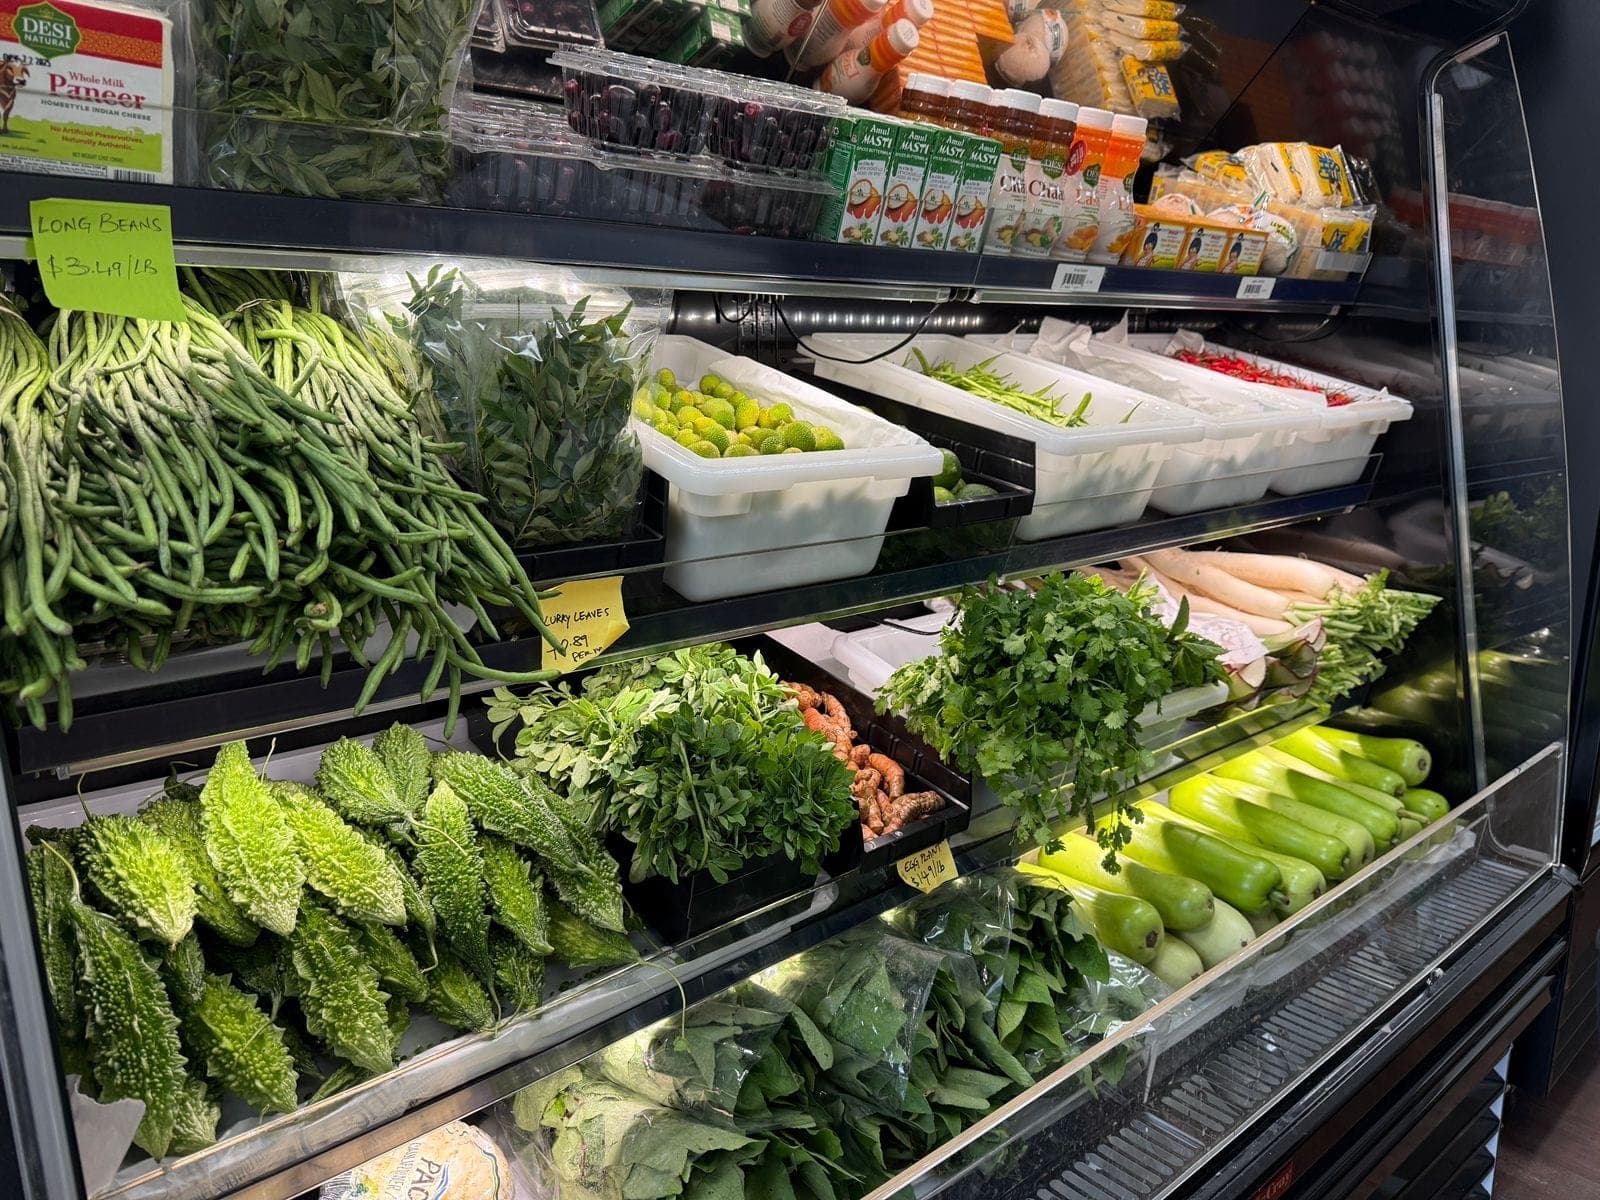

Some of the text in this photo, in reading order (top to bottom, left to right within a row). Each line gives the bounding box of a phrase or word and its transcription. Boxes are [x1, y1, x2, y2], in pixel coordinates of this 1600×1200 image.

[22, 16, 72, 40] DESI
[24, 33, 71, 49] NATURAL
[69, 71, 125, 88] Whole Milk
[48, 73, 147, 110] Paneer
[41, 98, 152, 121] HOMESTYLE INDIAN CHEESE
[51, 125, 62, 133] No
[62, 126, 94, 137] Artificial
[870, 124, 890, 136] Amul
[908, 131, 928, 142] Amul
[62, 135, 96, 147] Naturally
[861, 134, 892, 149] MASTI
[901, 140, 930, 154] MASTI
[937, 144, 966, 158] MASTI
[972, 151, 998, 165] MASTI
[38, 213, 162, 234] LONG BEANS
[45, 254, 157, 280] $3.49/LB
[573, 607, 610, 622] LEAVES
[904, 857, 920, 873] EGG
